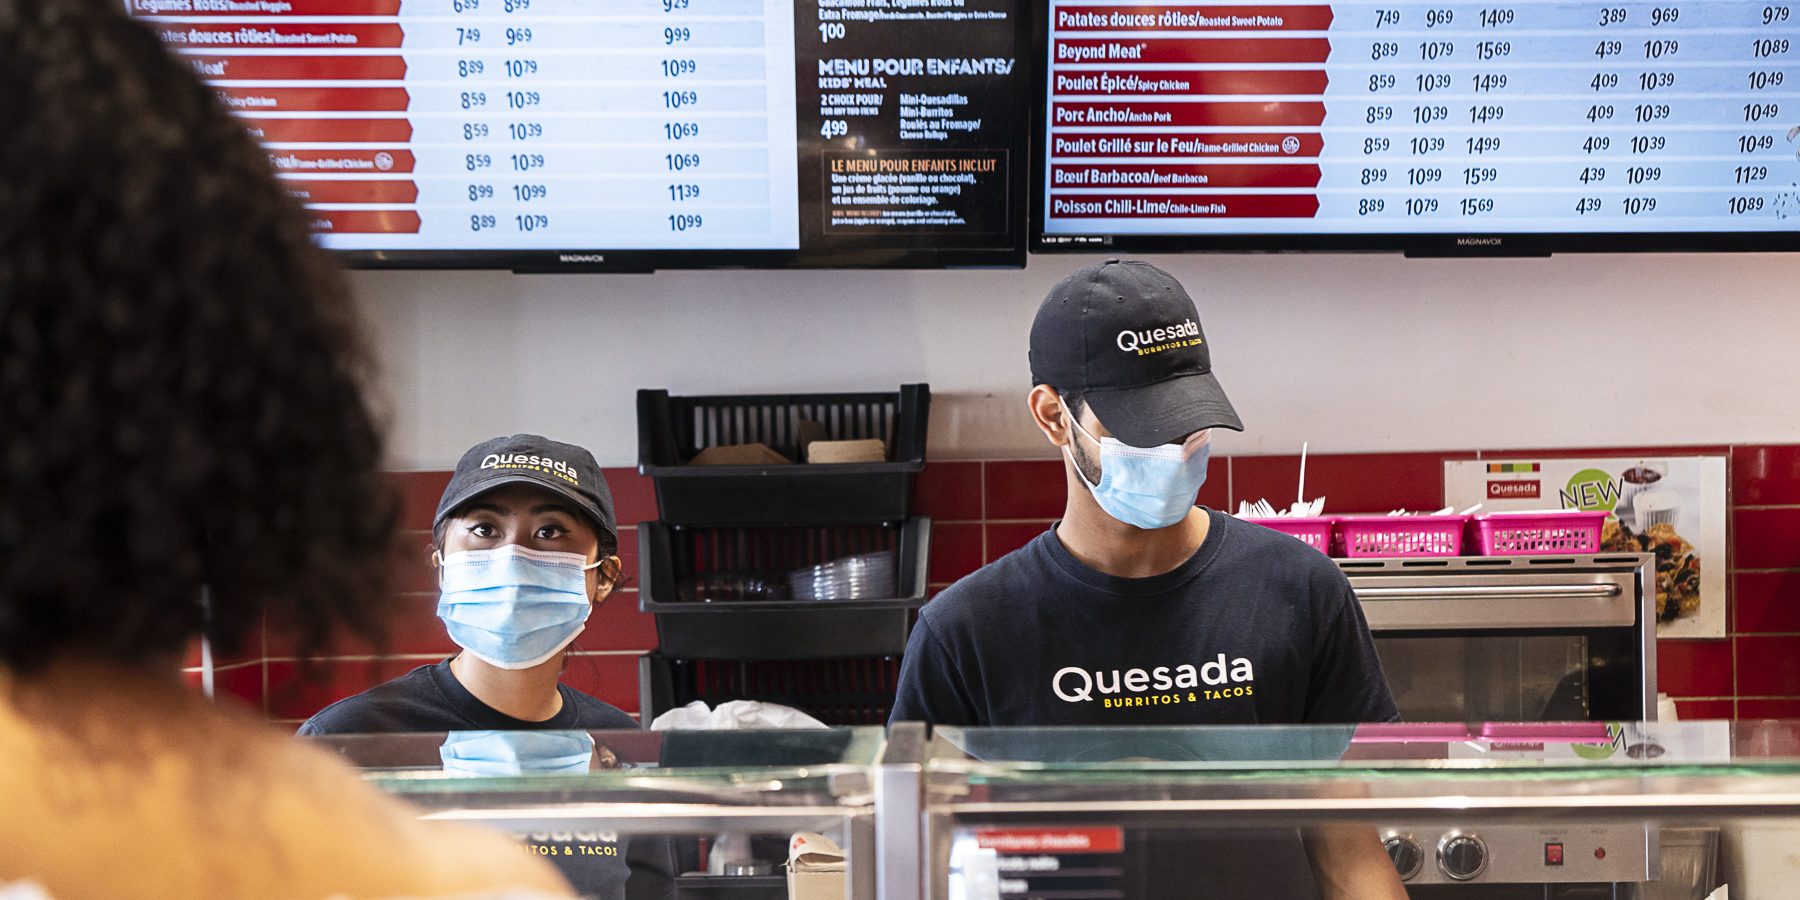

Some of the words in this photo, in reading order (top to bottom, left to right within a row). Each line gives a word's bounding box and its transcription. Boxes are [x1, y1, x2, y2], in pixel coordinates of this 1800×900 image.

[1059, 11, 1108, 27] Patates
[1110, 11, 1155, 27] douces
[1231, 16, 1256, 26] Sweet
[1257, 16, 1283, 26] Potato
[1376, 10, 1400, 28] 749
[1427, 9, 1453, 28] 969
[1480, 9, 1514, 28] 1409
[1599, 8, 1626, 27] 389
[1652, 7, 1679, 26] 969
[1763, 7, 1789, 25] 979
[188, 29, 233, 43] douces
[456, 28, 480, 45] 749
[506, 28, 531, 45] 969
[665, 27, 690, 45] 999
[1058, 43, 1106, 62] Beyond
[1372, 42, 1398, 60] 889
[1420, 42, 1453, 60] 1079
[1476, 41, 1510, 60] 1569
[1595, 41, 1621, 59] 439
[1644, 40, 1678, 59] 1079
[1753, 39, 1789, 58] 1089
[458, 60, 483, 77] 889
[505, 60, 537, 77] 1079
[662, 60, 695, 77] 1099
[818, 59, 870, 76] MENU
[872, 59, 924, 76] POUR
[926, 58, 1016, 76] ENFANTS/
[818, 77, 853, 89] KIDS'
[854, 77, 888, 89] MEAL
[1057, 75, 1099, 91] Poulet
[1159, 80, 1190, 91] Chicken
[1369, 74, 1395, 92] 859
[1416, 74, 1451, 92] 1039
[1473, 74, 1507, 92] 1499
[1591, 73, 1618, 91] 409
[1640, 72, 1674, 91] 1039
[1749, 71, 1783, 90] 1049
[461, 92, 486, 109] 859
[507, 92, 539, 108] 1039
[663, 91, 697, 108] 1069
[820, 94, 828, 106] 2
[828, 94, 855, 106] CHOIX
[900, 107, 954, 118] Mini-Burritos
[1056, 107, 1085, 122] Porc
[1153, 112, 1172, 122] Pork
[1366, 106, 1392, 124] 859
[1414, 106, 1447, 124] 1039
[1470, 106, 1503, 123] 1499
[1587, 105, 1614, 123] 409
[1635, 105, 1669, 123] 1039
[1744, 104, 1778, 122] 1049
[464, 123, 488, 140] 859
[509, 123, 542, 140] 1039
[665, 123, 698, 140] 1069
[820, 119, 848, 140] 499
[929, 121, 940, 130] au
[1055, 138, 1096, 153] Poulet
[1098, 137, 1132, 153] Grillé
[1133, 140, 1154, 153] sur
[1156, 138, 1169, 153] le
[1249, 143, 1280, 153] Chicken
[1364, 138, 1389, 155] 859
[1411, 137, 1444, 155] 1039
[1467, 137, 1500, 154] 1499
[1583, 136, 1609, 154] 409
[1631, 136, 1665, 154] 1039
[1739, 135, 1773, 153] 1049
[466, 154, 491, 171] 859
[511, 154, 544, 171] 1039
[666, 154, 699, 170] 1069
[831, 160, 844, 172] LE
[846, 160, 878, 172] MENU
[879, 160, 909, 172] POUR
[911, 160, 957, 172] ENFANTS
[959, 159, 997, 172] INCLUT
[831, 174, 847, 183] Une
[928, 175, 939, 183] ou
[1172, 173, 1208, 183] Barbacoa
[1361, 168, 1387, 185] 899
[1408, 168, 1441, 185] 1099
[1464, 168, 1496, 185] 1599
[1580, 167, 1605, 184] 439
[1627, 167, 1661, 184] 1099
[1735, 166, 1767, 184] 1129
[468, 185, 493, 201] 899
[513, 185, 546, 201] 1099
[669, 184, 699, 200] 1139
[831, 186, 842, 194] un
[920, 186, 930, 194] ou
[1054, 199, 1102, 214] Poisson
[1210, 203, 1227, 214] Fish
[1359, 199, 1384, 216] 889
[1405, 198, 1438, 215] 1079
[1460, 198, 1493, 215] 1569
[1576, 198, 1601, 215] 439
[1623, 197, 1656, 215] 1079
[1729, 197, 1763, 214] 1089
[471, 215, 496, 231] 889
[516, 215, 548, 231] 1079
[669, 215, 702, 231] 1099
[1457, 238, 1502, 246] MAGNAVOX
[1117, 318, 1200, 352] Quesada
[1137, 340, 1182, 356] BURRITOS
[480, 453, 579, 480] Quesada
[553, 470, 579, 486] TACOS
[1490, 483, 1537, 495] Quesada
[1558, 477, 1625, 510] NEW
[1052, 653, 1254, 703] Quesada
[1104, 692, 1181, 709] BURRITOS
[1187, 692, 1197, 702] &
[1204, 685, 1254, 701] TACOS
[564, 845, 573, 856] &
[578, 845, 617, 857] TACOS
